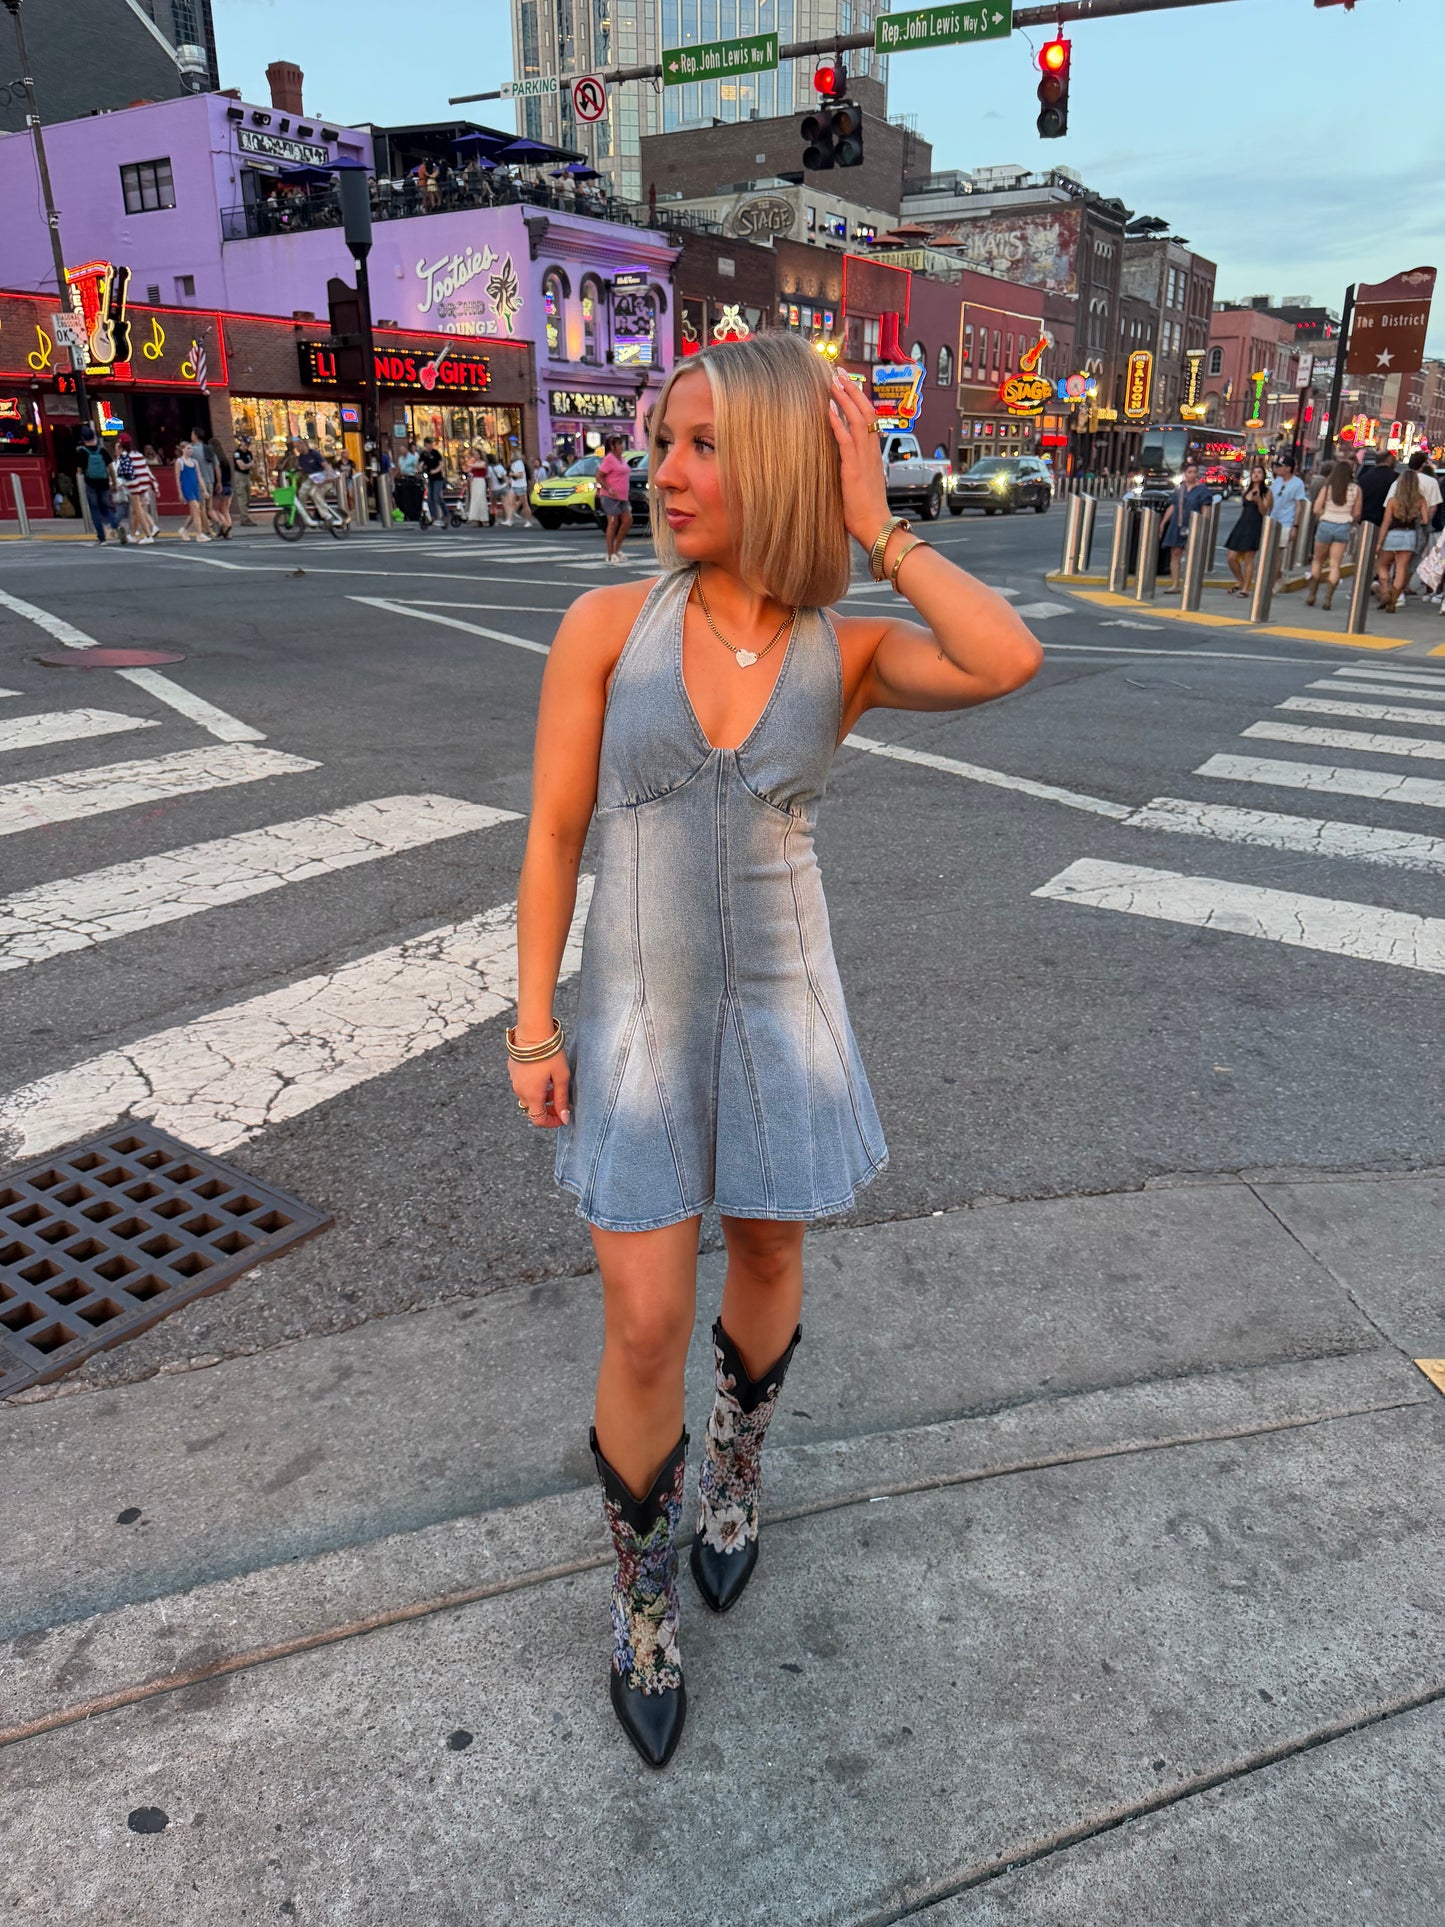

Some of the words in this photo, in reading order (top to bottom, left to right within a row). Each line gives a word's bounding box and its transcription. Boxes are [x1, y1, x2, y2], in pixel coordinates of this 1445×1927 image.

[881, 21, 902, 46] Rep.
[903, 15, 927, 40] John
[930, 10, 960, 36] Lewis
[963, 15, 979, 34] Way
[980, 8, 988, 32] S
[680, 52, 699, 76] Rep.
[699, 49, 721, 71] John
[722, 44, 749, 67] Lewis
[751, 46, 764, 63] Way
[766, 41, 773, 62] N
[511, 77, 558, 97] PARKING
[736, 206, 791, 237] STAGE
[416, 243, 499, 314] Tootsies
[437, 320, 498, 335] LOUNGE
[1357, 316, 1374, 328] The
[1381, 313, 1426, 328] District
[56, 328, 70, 342] OK
[439, 361, 487, 386] GIFTS
[1131, 360, 1145, 409] SALOON
[1004, 380, 1052, 403] STAGE
